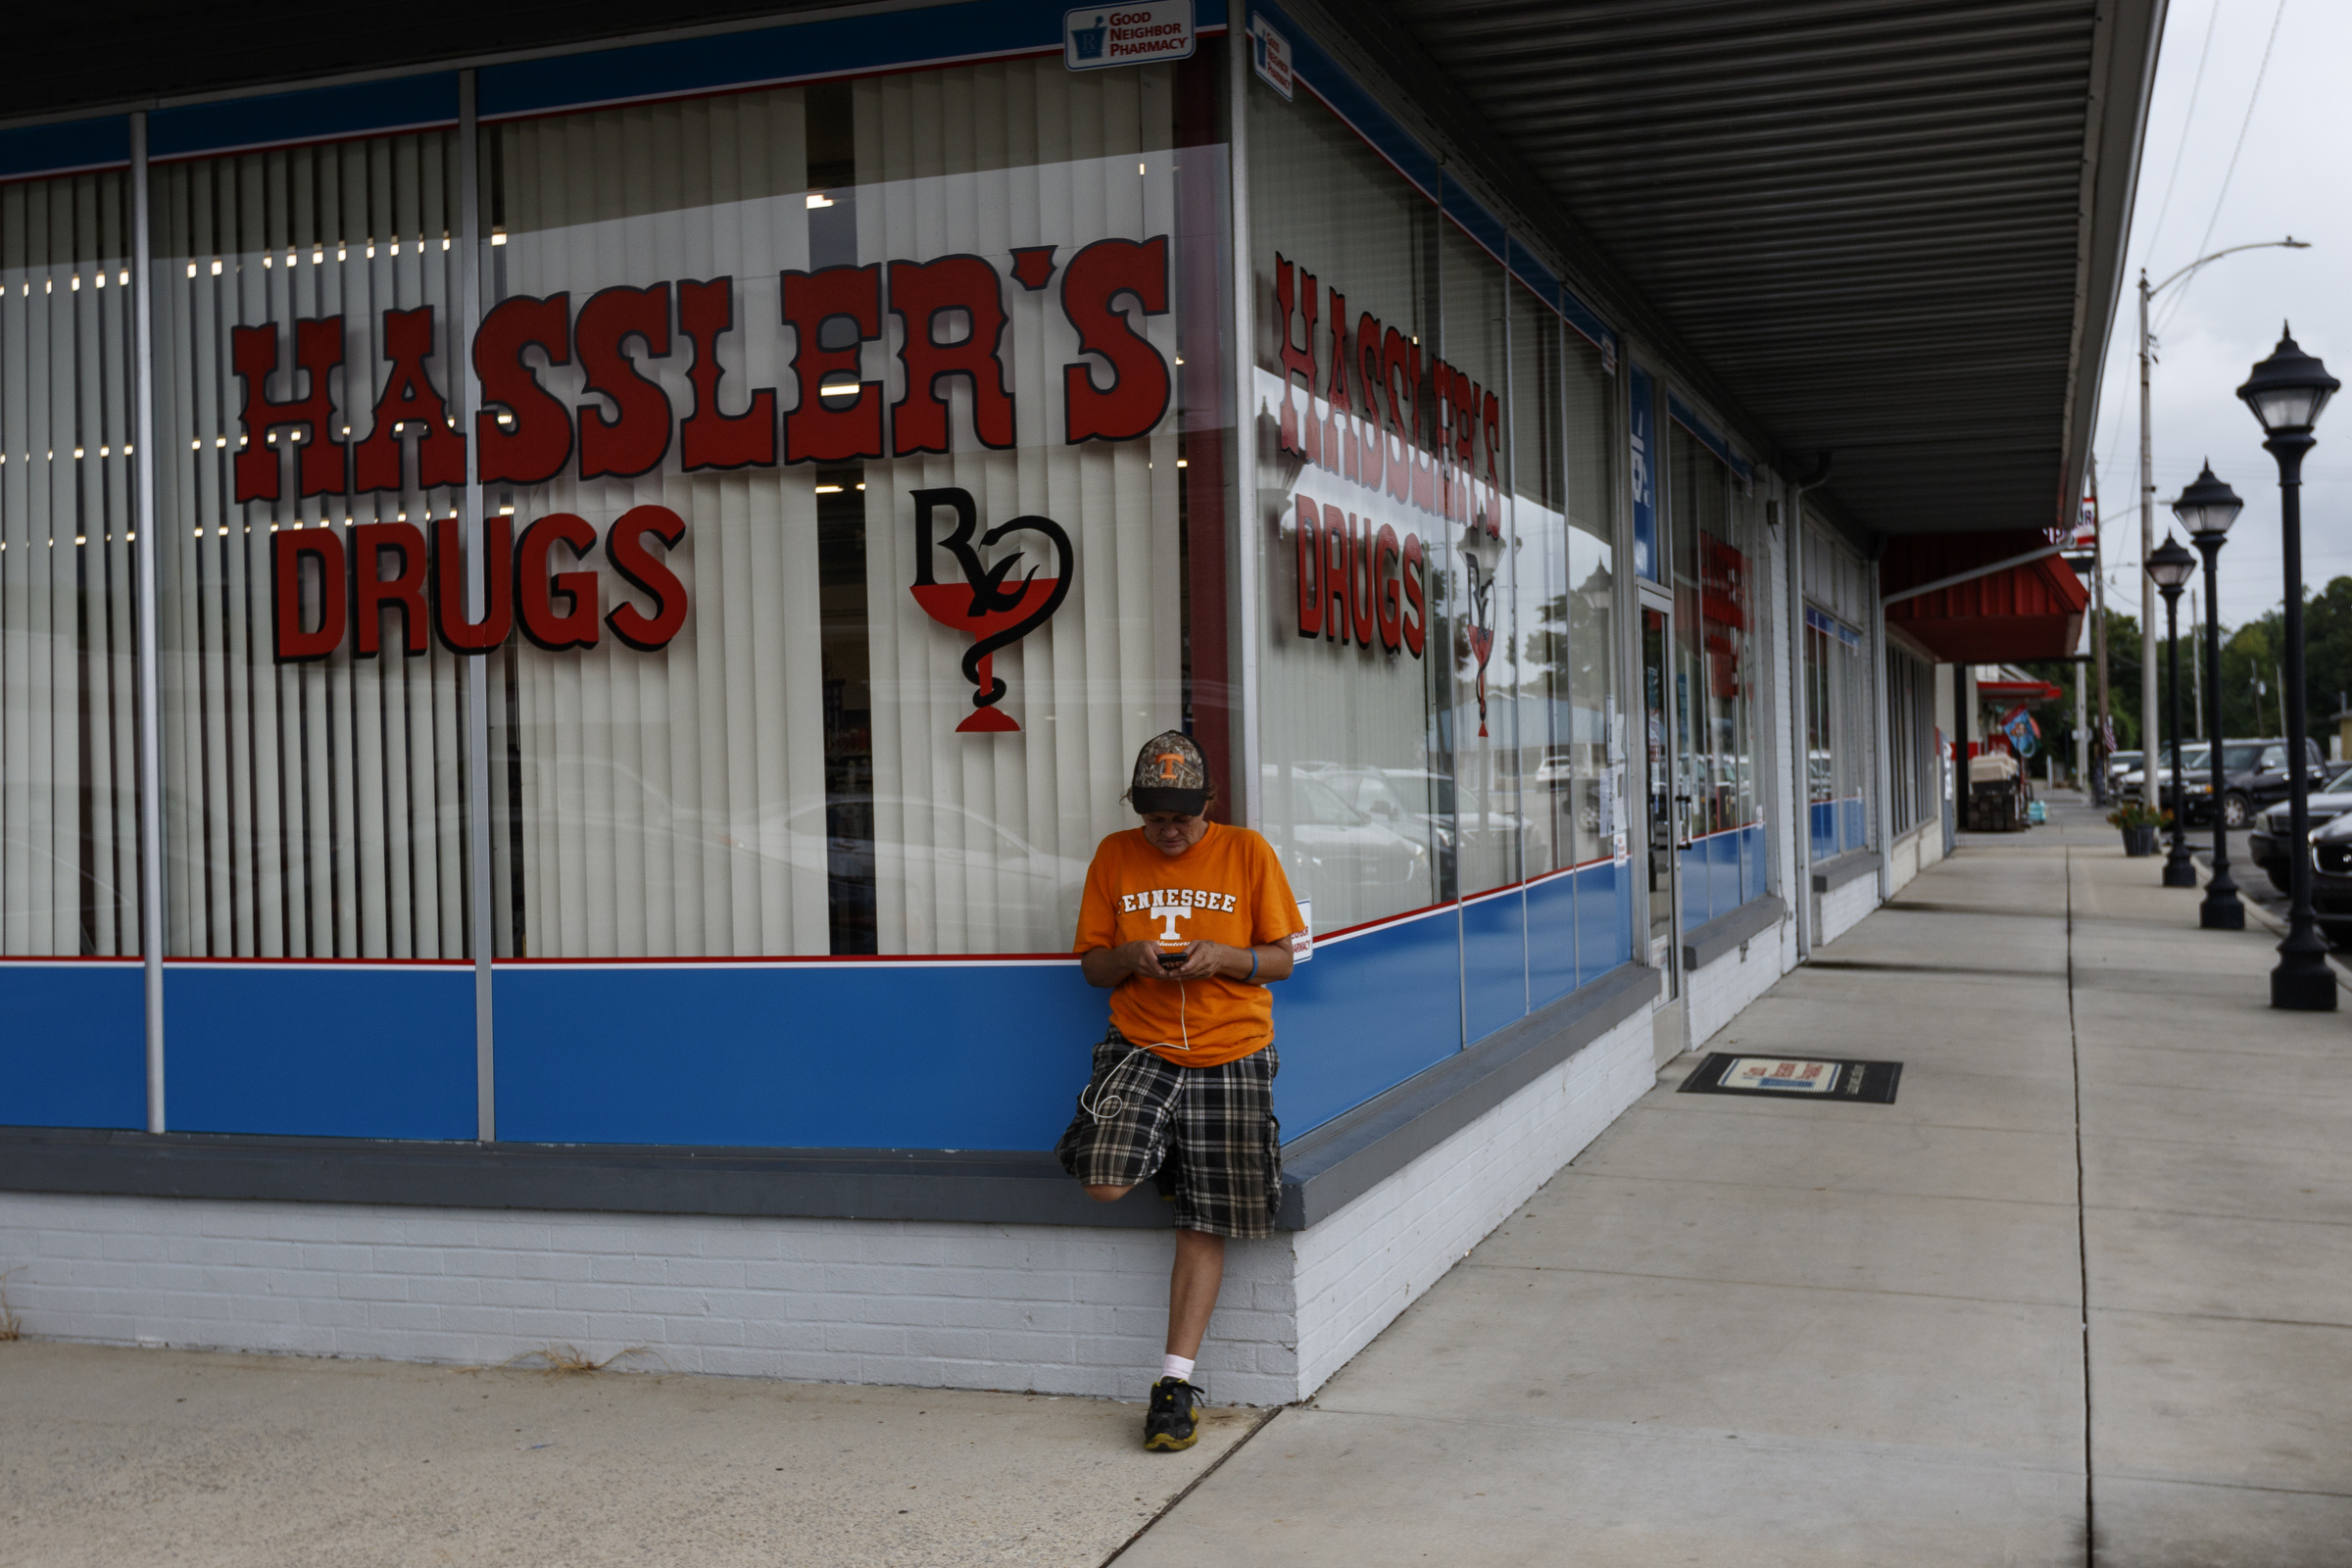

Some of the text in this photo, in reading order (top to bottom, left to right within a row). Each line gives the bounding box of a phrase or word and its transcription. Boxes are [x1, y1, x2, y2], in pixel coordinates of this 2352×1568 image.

[1109, 12, 1151, 25] GOOD
[1110, 24, 1181, 41] NEIGHBOR
[1110, 37, 1187, 57] PHARMACY
[231, 234, 1171, 504] HASSLER'S
[1276, 251, 1501, 541] HASSLER'S
[271, 504, 687, 664] DRUGS
[1296, 493, 1426, 660] DRUGS
[1155, 754, 1185, 779] T
[1117, 889, 1237, 914] ENNESSEE
[1151, 906, 1192, 940] T
